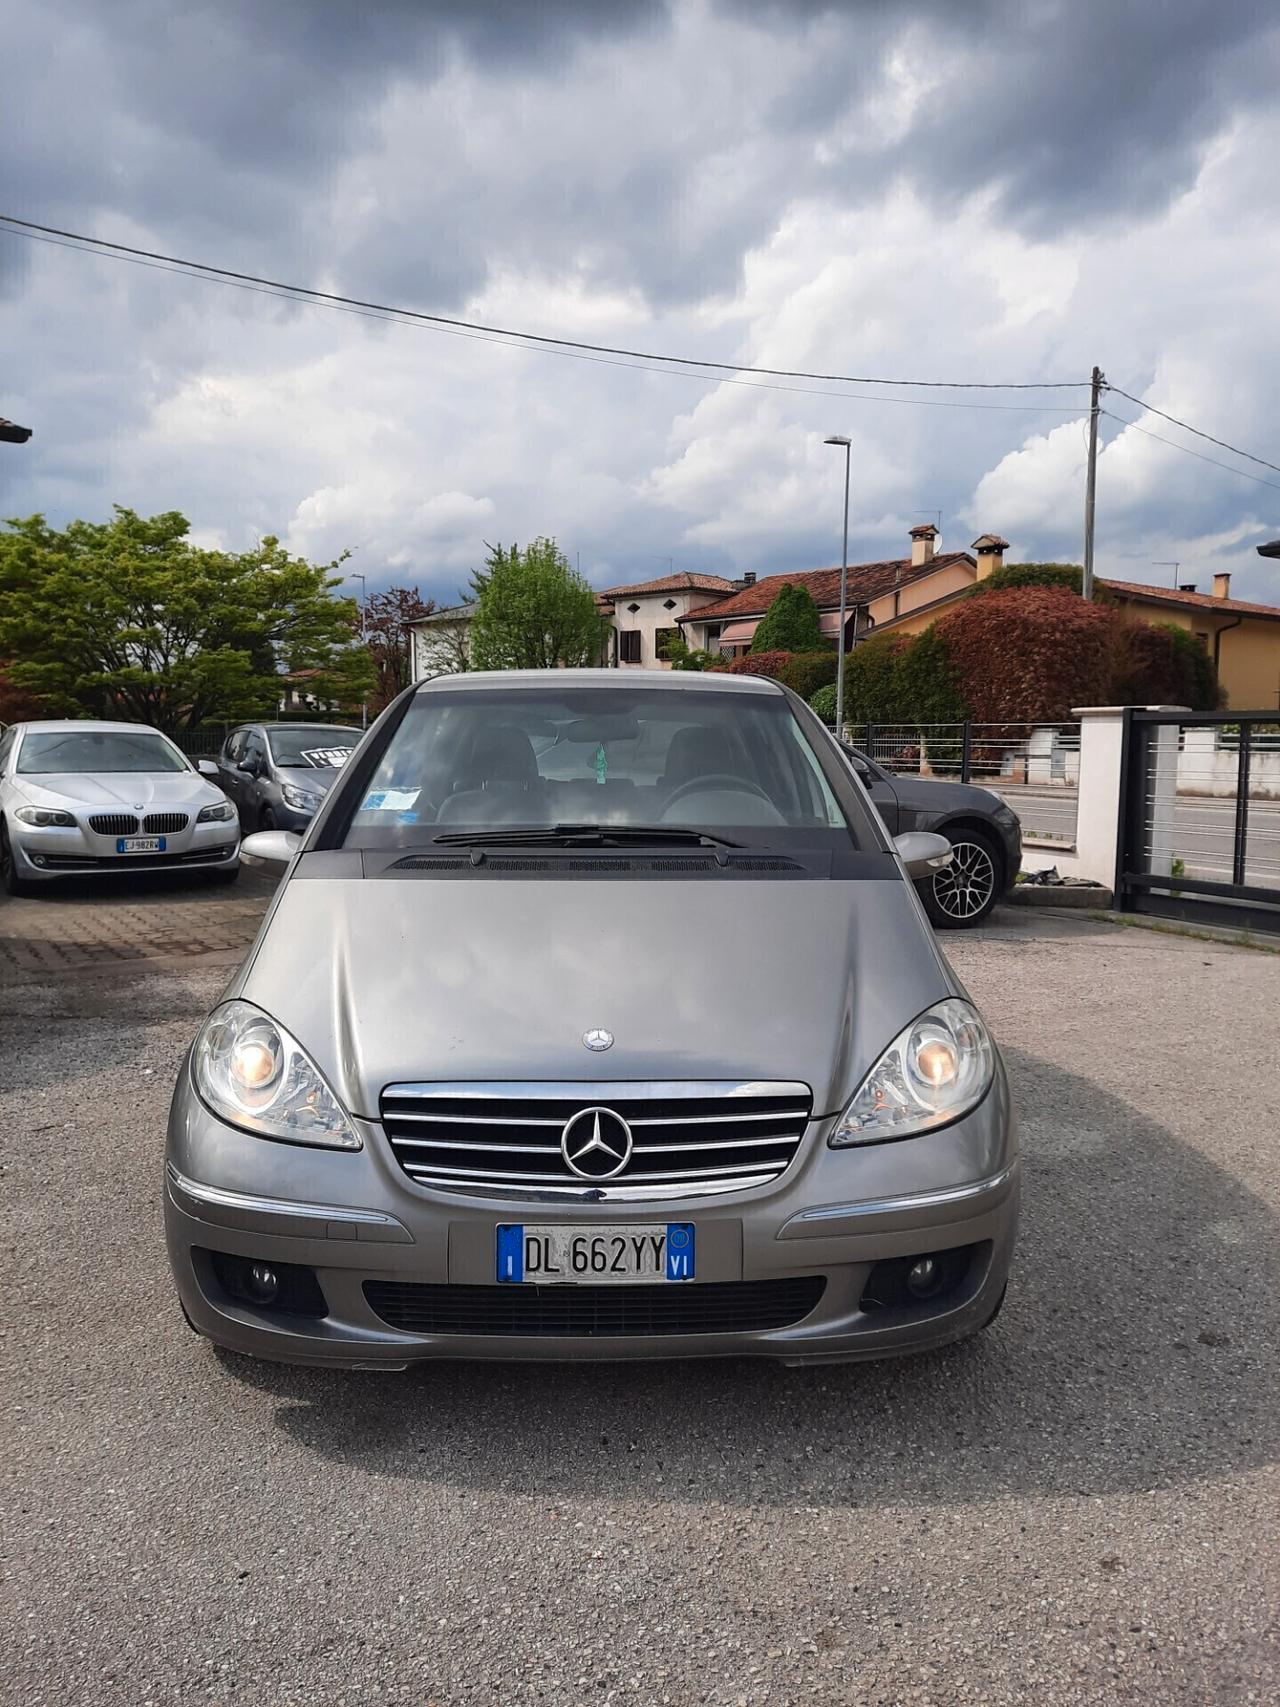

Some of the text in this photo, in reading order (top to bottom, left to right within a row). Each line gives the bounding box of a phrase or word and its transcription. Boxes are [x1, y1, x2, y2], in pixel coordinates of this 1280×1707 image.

[525, 1236, 665, 1273] DL 662YY
[670, 1255, 688, 1276] VI
